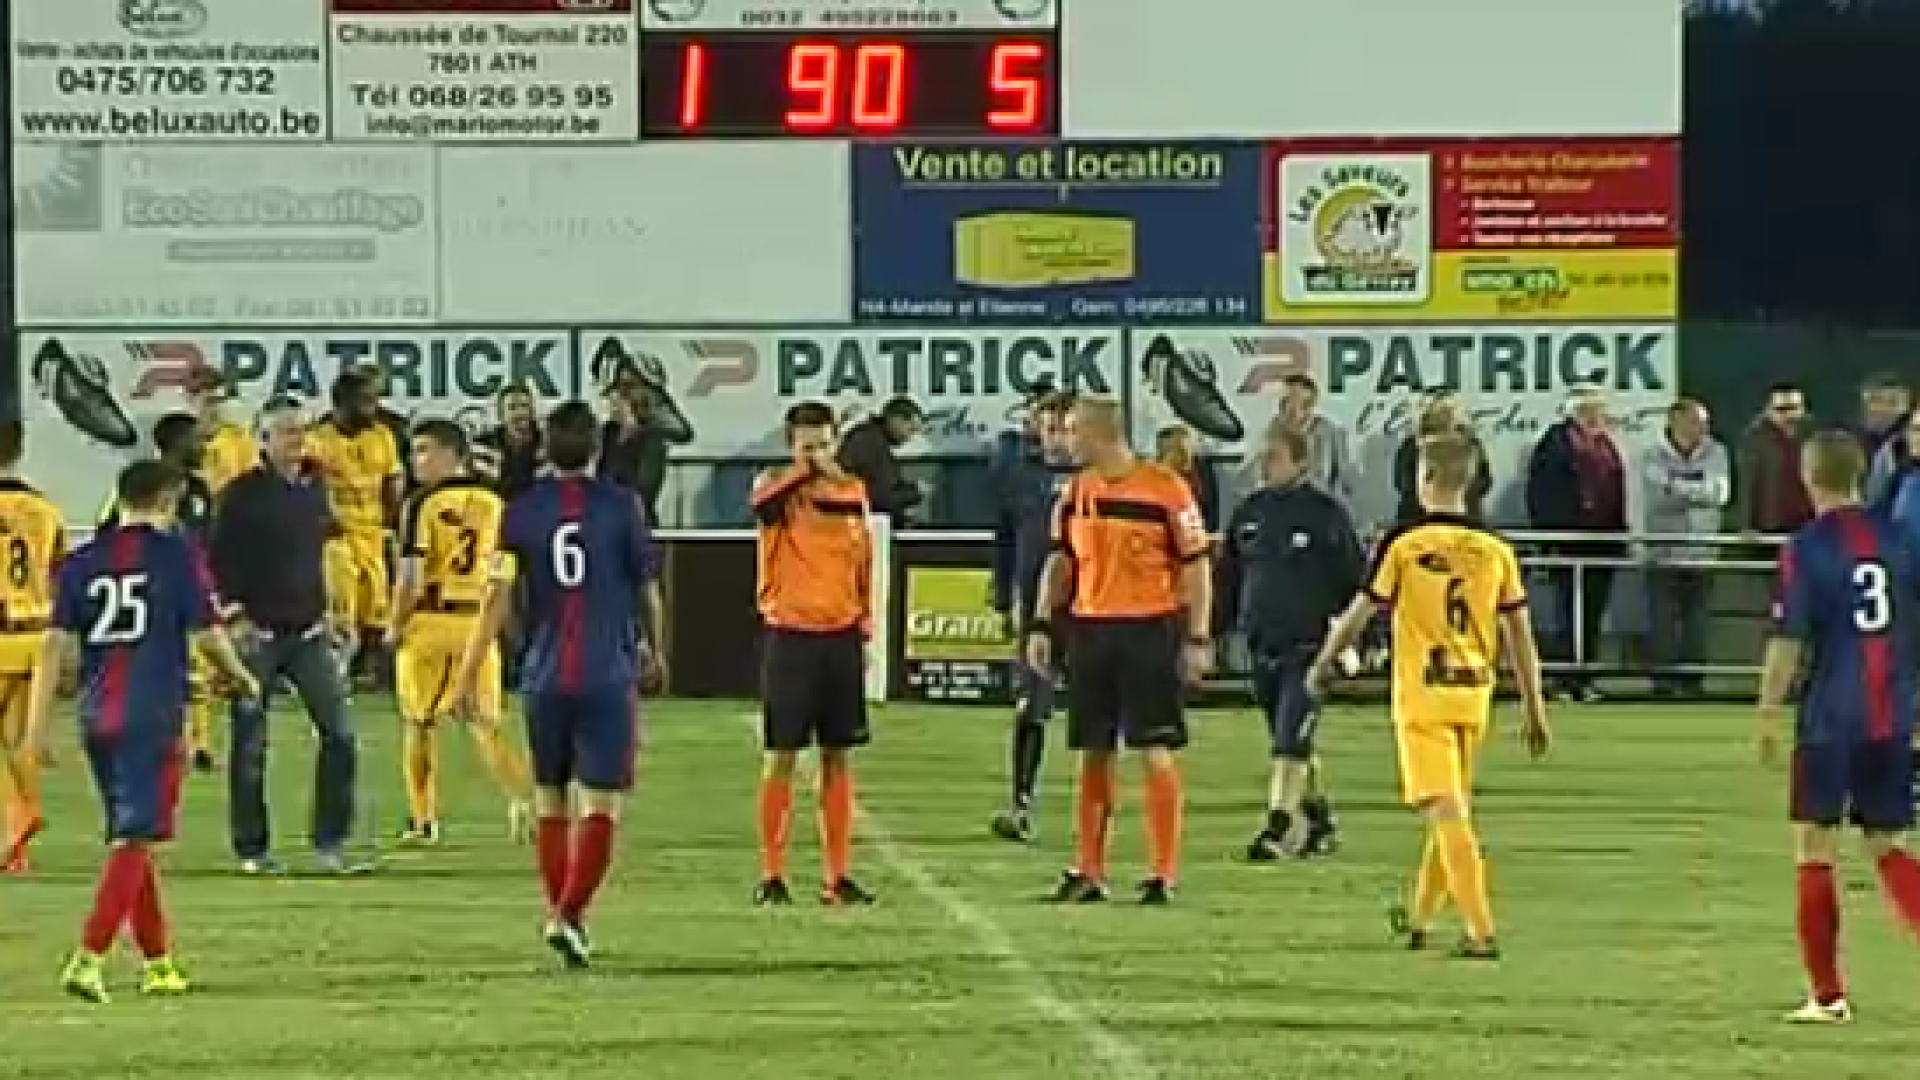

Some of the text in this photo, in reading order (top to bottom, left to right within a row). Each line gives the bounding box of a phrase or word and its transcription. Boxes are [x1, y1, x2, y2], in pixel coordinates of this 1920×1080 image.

[338, 24, 453, 44] Chaussée
[457, 24, 489, 44] de
[584, 24, 628, 44] 220
[488, 52, 537, 73] ATH
[58, 66, 275, 95] 0475/706 732
[350, 82, 614, 110] Tél 068/26 95 95
[680, 42, 1044, 128] 1 90 5
[22, 106, 320, 134] www.beluxauto.be
[366, 115, 601, 135] info@mariomotor.be
[894, 146, 1223, 179] Vente et location
[1286, 164, 1409, 225] Les Saveurs
[221, 339, 562, 399] PATRICK
[776, 335, 1112, 397] PATRICK
[1326, 333, 1665, 396] PATRICK
[450, 528, 478, 577] 3
[552, 521, 586, 588] 6
[87, 571, 149, 644] 25
[1446, 577, 1471, 637] 6
[1851, 560, 1893, 632] 3
